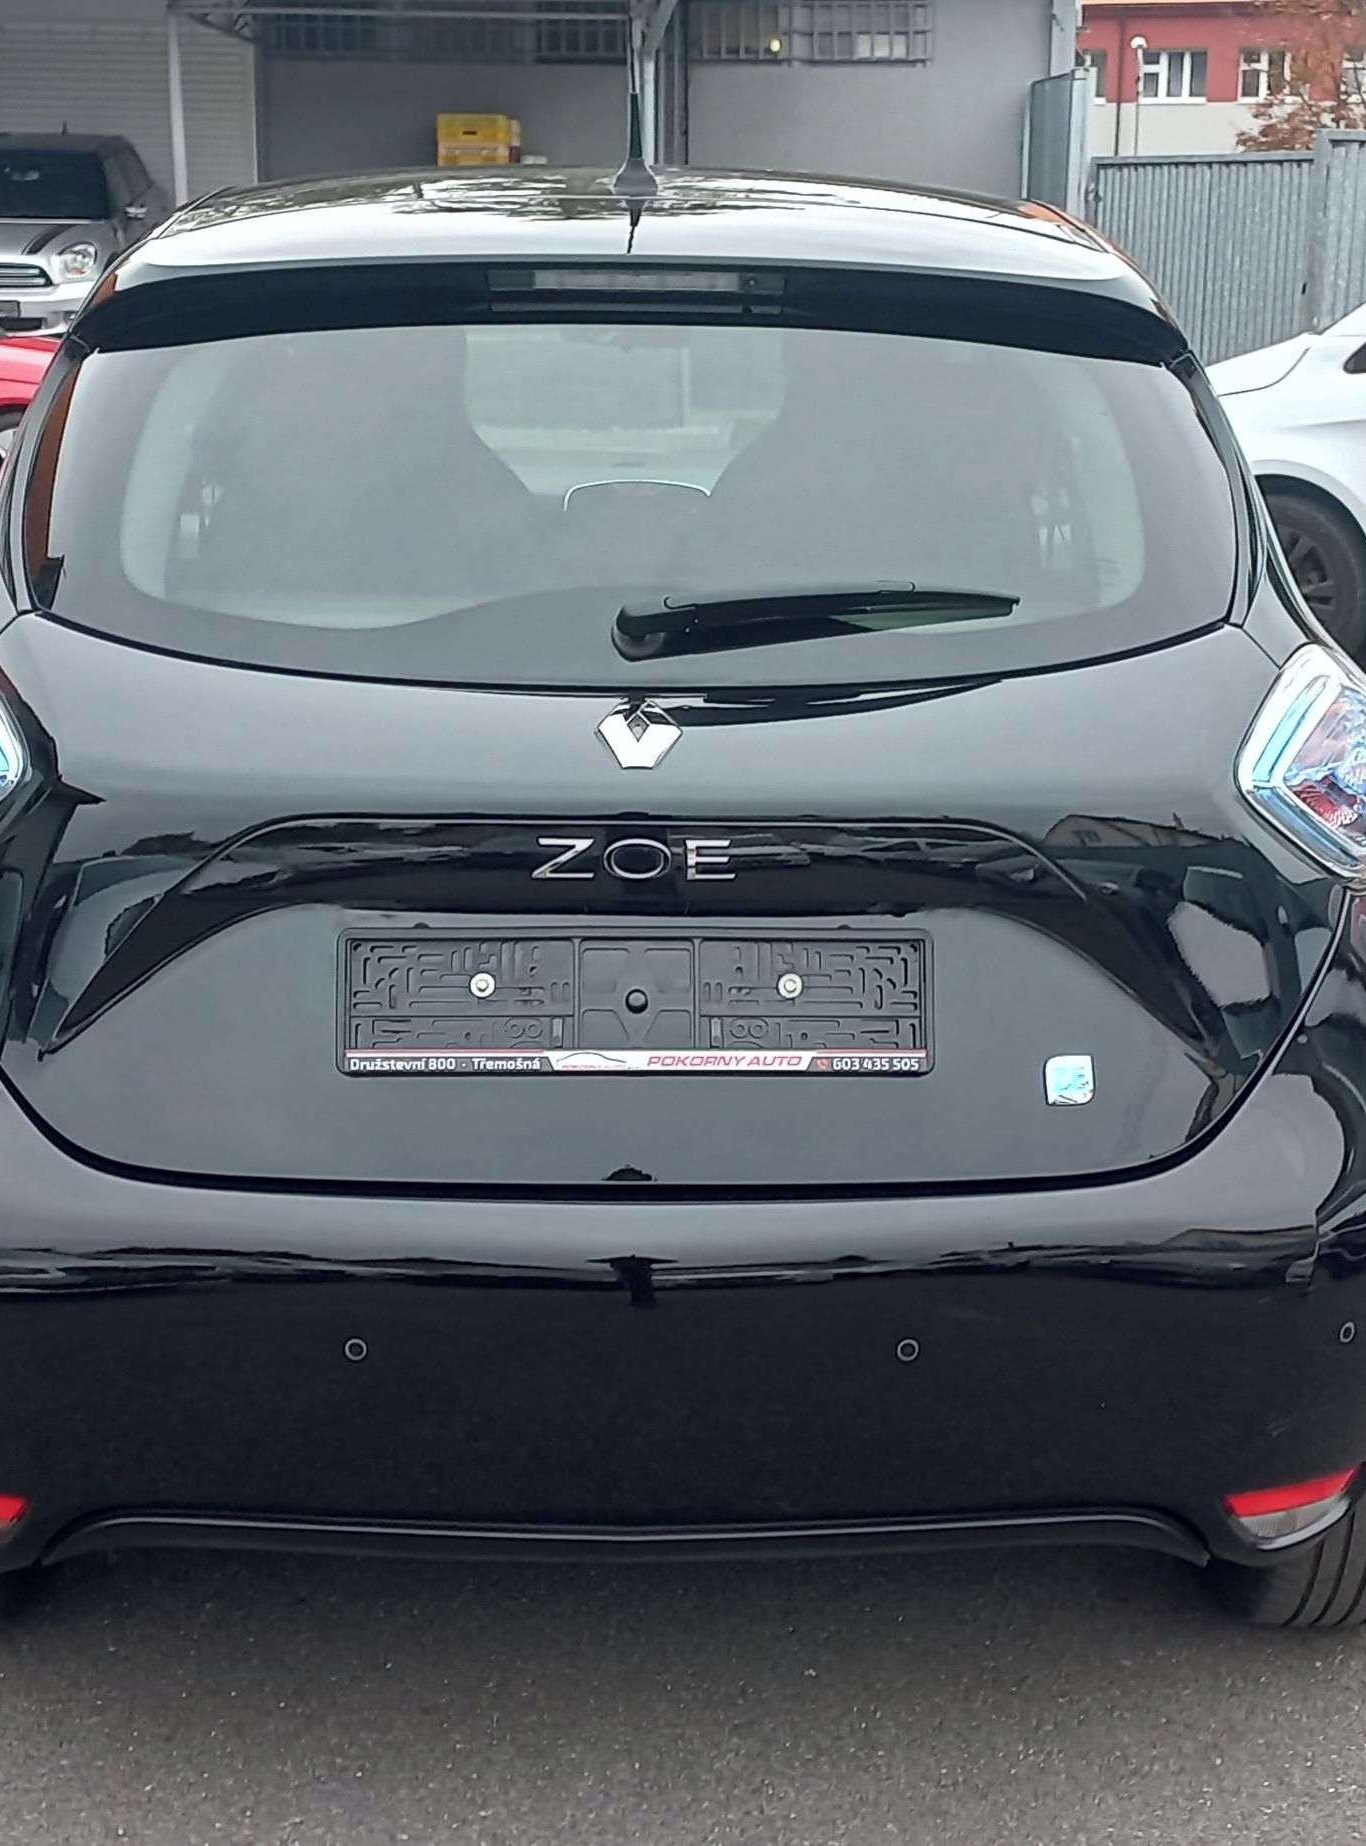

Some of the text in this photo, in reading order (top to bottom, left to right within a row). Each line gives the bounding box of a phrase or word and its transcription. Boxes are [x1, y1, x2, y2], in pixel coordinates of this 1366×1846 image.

[531, 837, 737, 881] ZOE
[349, 1056, 541, 1071] Družstevní 800 Třemošná
[747, 1055, 803, 1067] AUTO
[832, 1057, 920, 1071] 603 435 505
